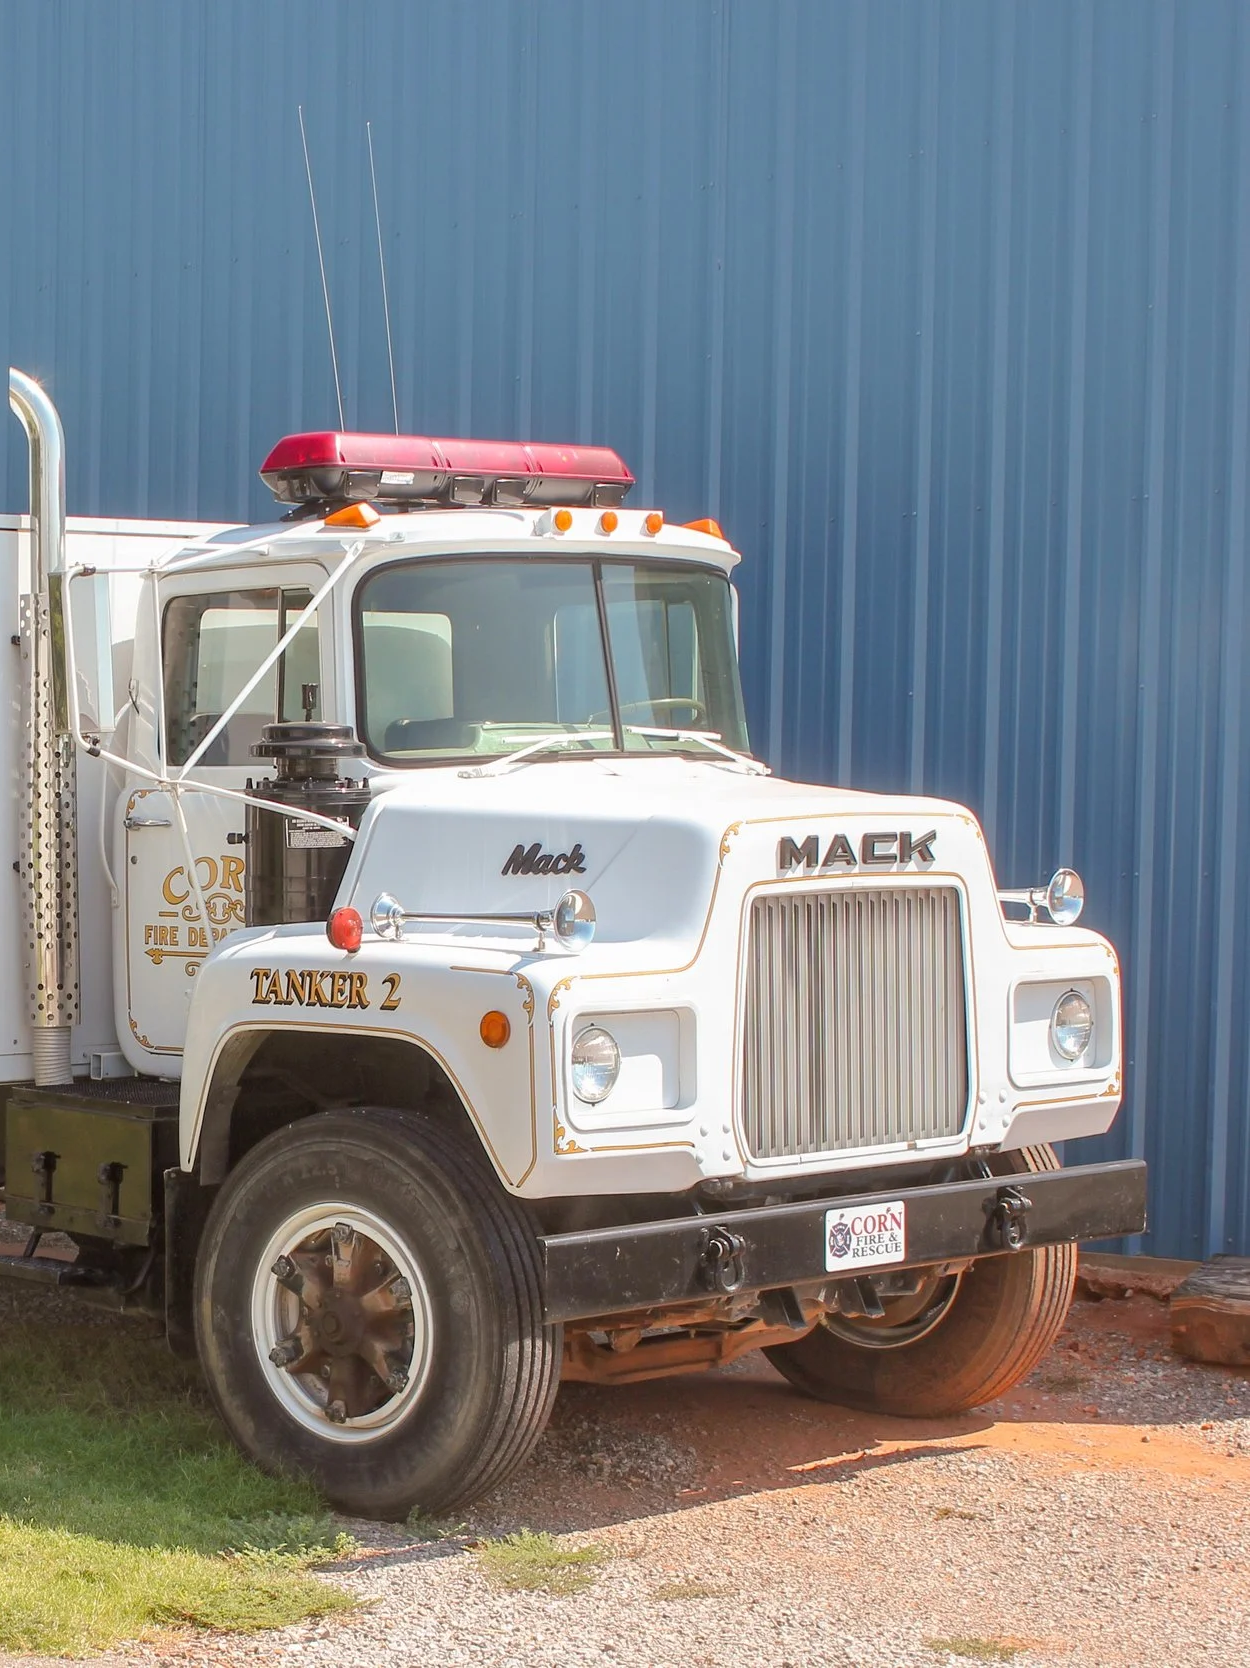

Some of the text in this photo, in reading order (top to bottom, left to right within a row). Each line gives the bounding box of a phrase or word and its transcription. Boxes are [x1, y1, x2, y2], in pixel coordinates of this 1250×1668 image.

[501, 843, 587, 876] Mack
[779, 829, 937, 870] MACK
[162, 855, 246, 905] COR
[144, 925, 179, 946] FIRE
[250, 967, 402, 1011] TANKER 2
[851, 1212, 902, 1236] CORN
[852, 1242, 902, 1258] RESCUE
[856, 1232, 899, 1247] FIRE &
